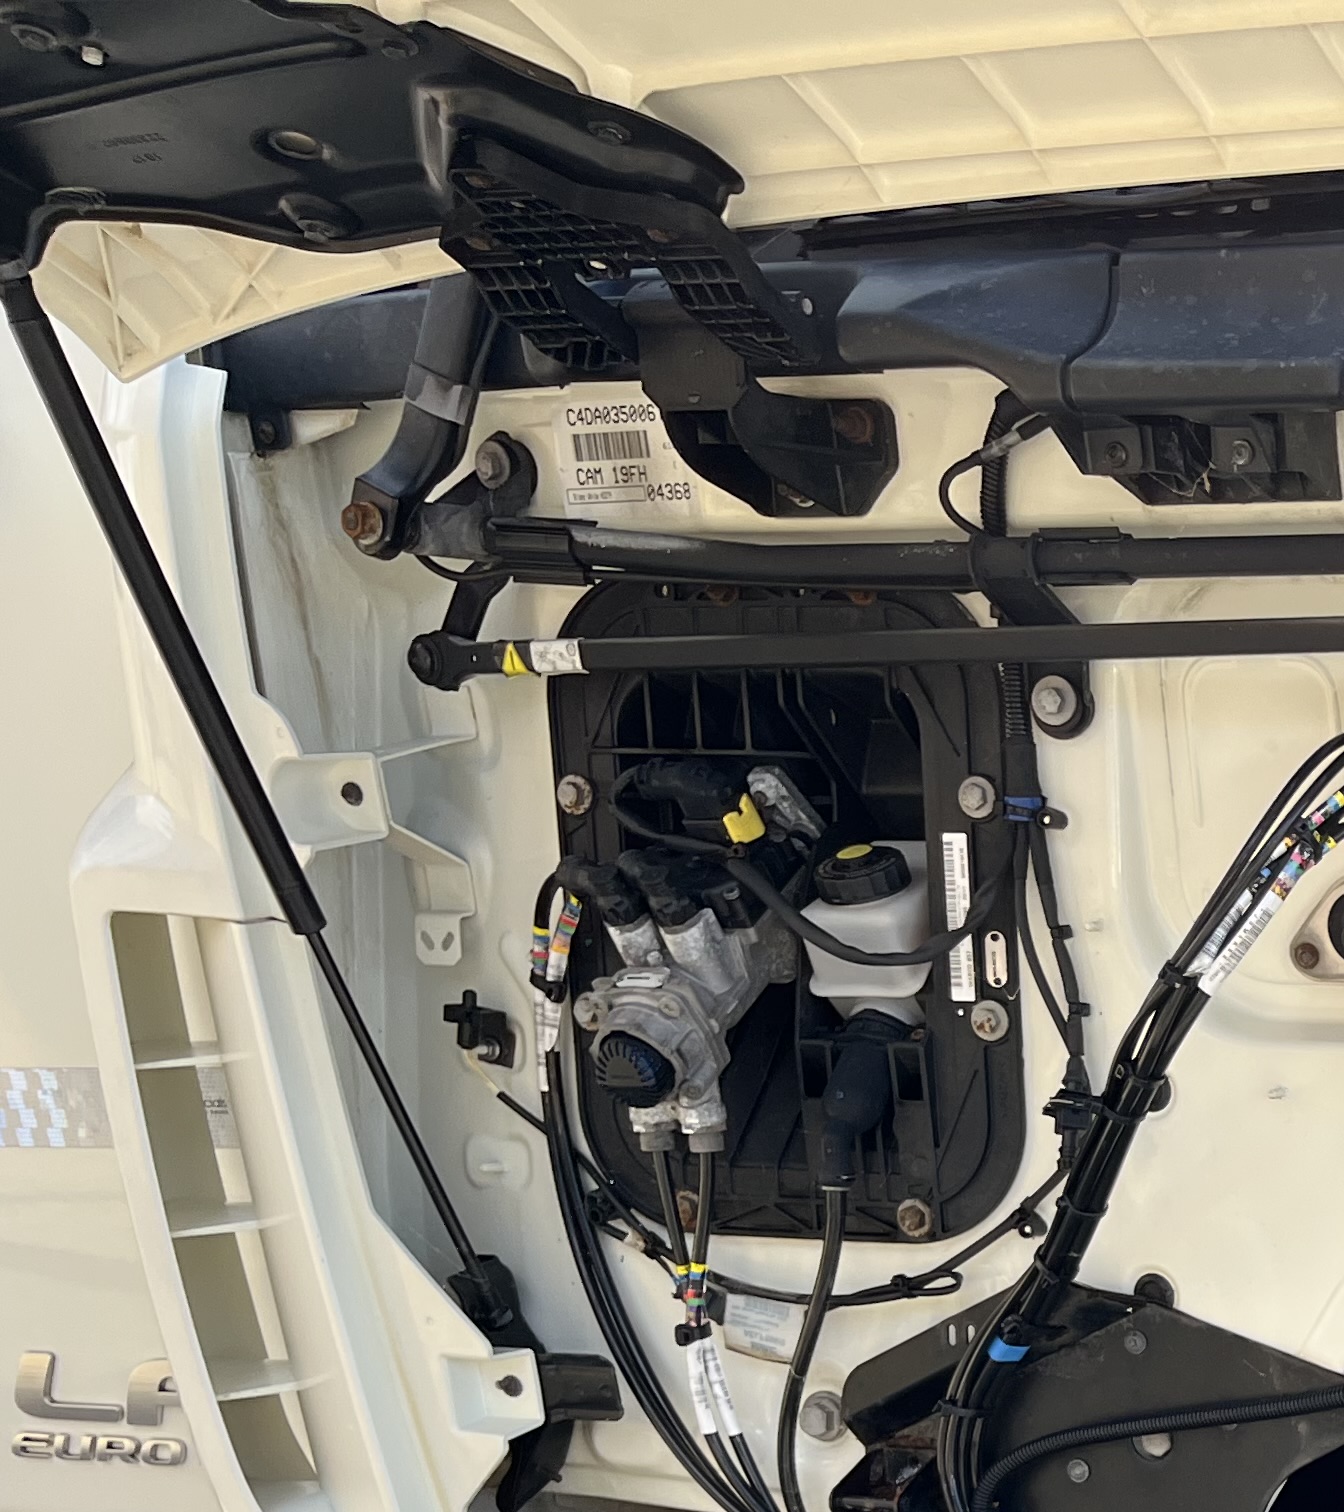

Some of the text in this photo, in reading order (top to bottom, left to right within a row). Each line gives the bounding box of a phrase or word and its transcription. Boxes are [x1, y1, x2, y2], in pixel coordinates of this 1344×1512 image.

[566, 404, 656, 427] C4DA035006
[576, 467, 605, 486] CAM
[11, 1431, 188, 1466] EURO
